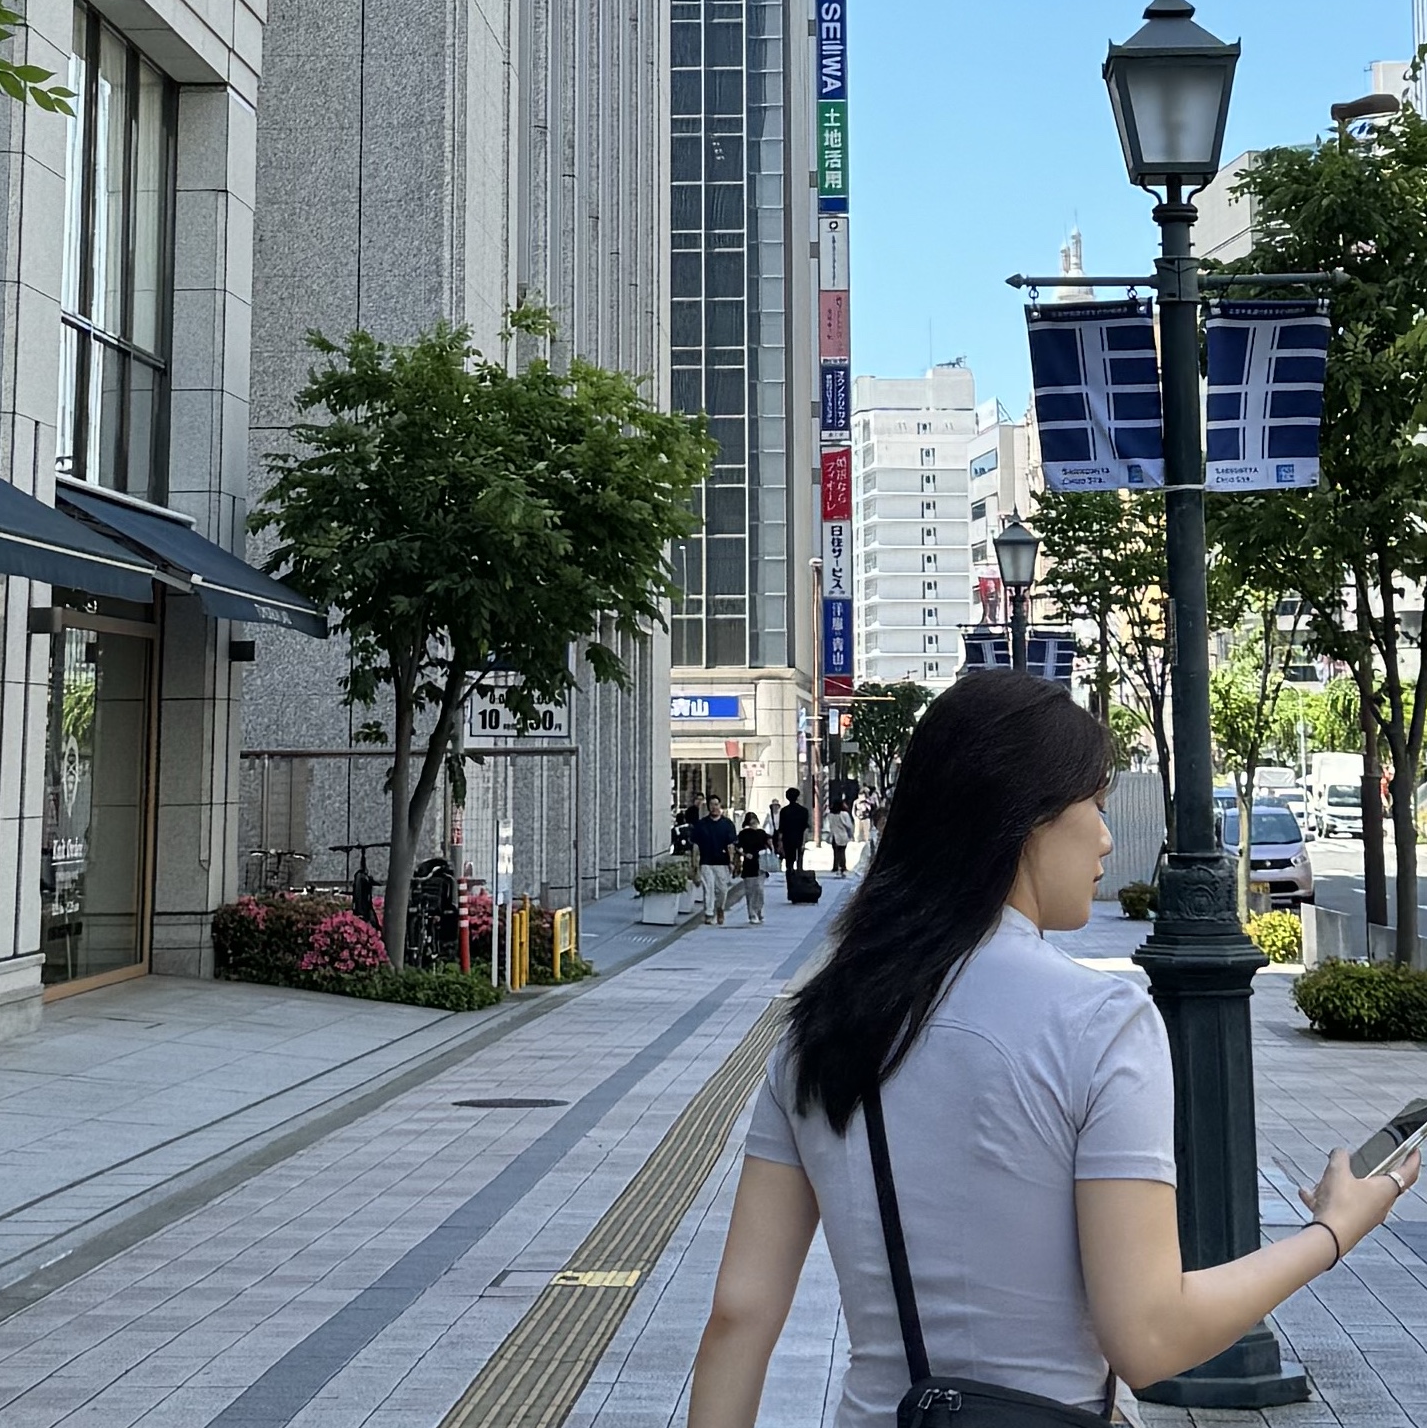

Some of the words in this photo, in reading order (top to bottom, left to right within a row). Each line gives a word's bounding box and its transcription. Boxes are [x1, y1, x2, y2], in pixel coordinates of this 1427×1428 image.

[824, 107, 843, 189] 土地活用
[830, 525, 843, 590] 日住サービス
